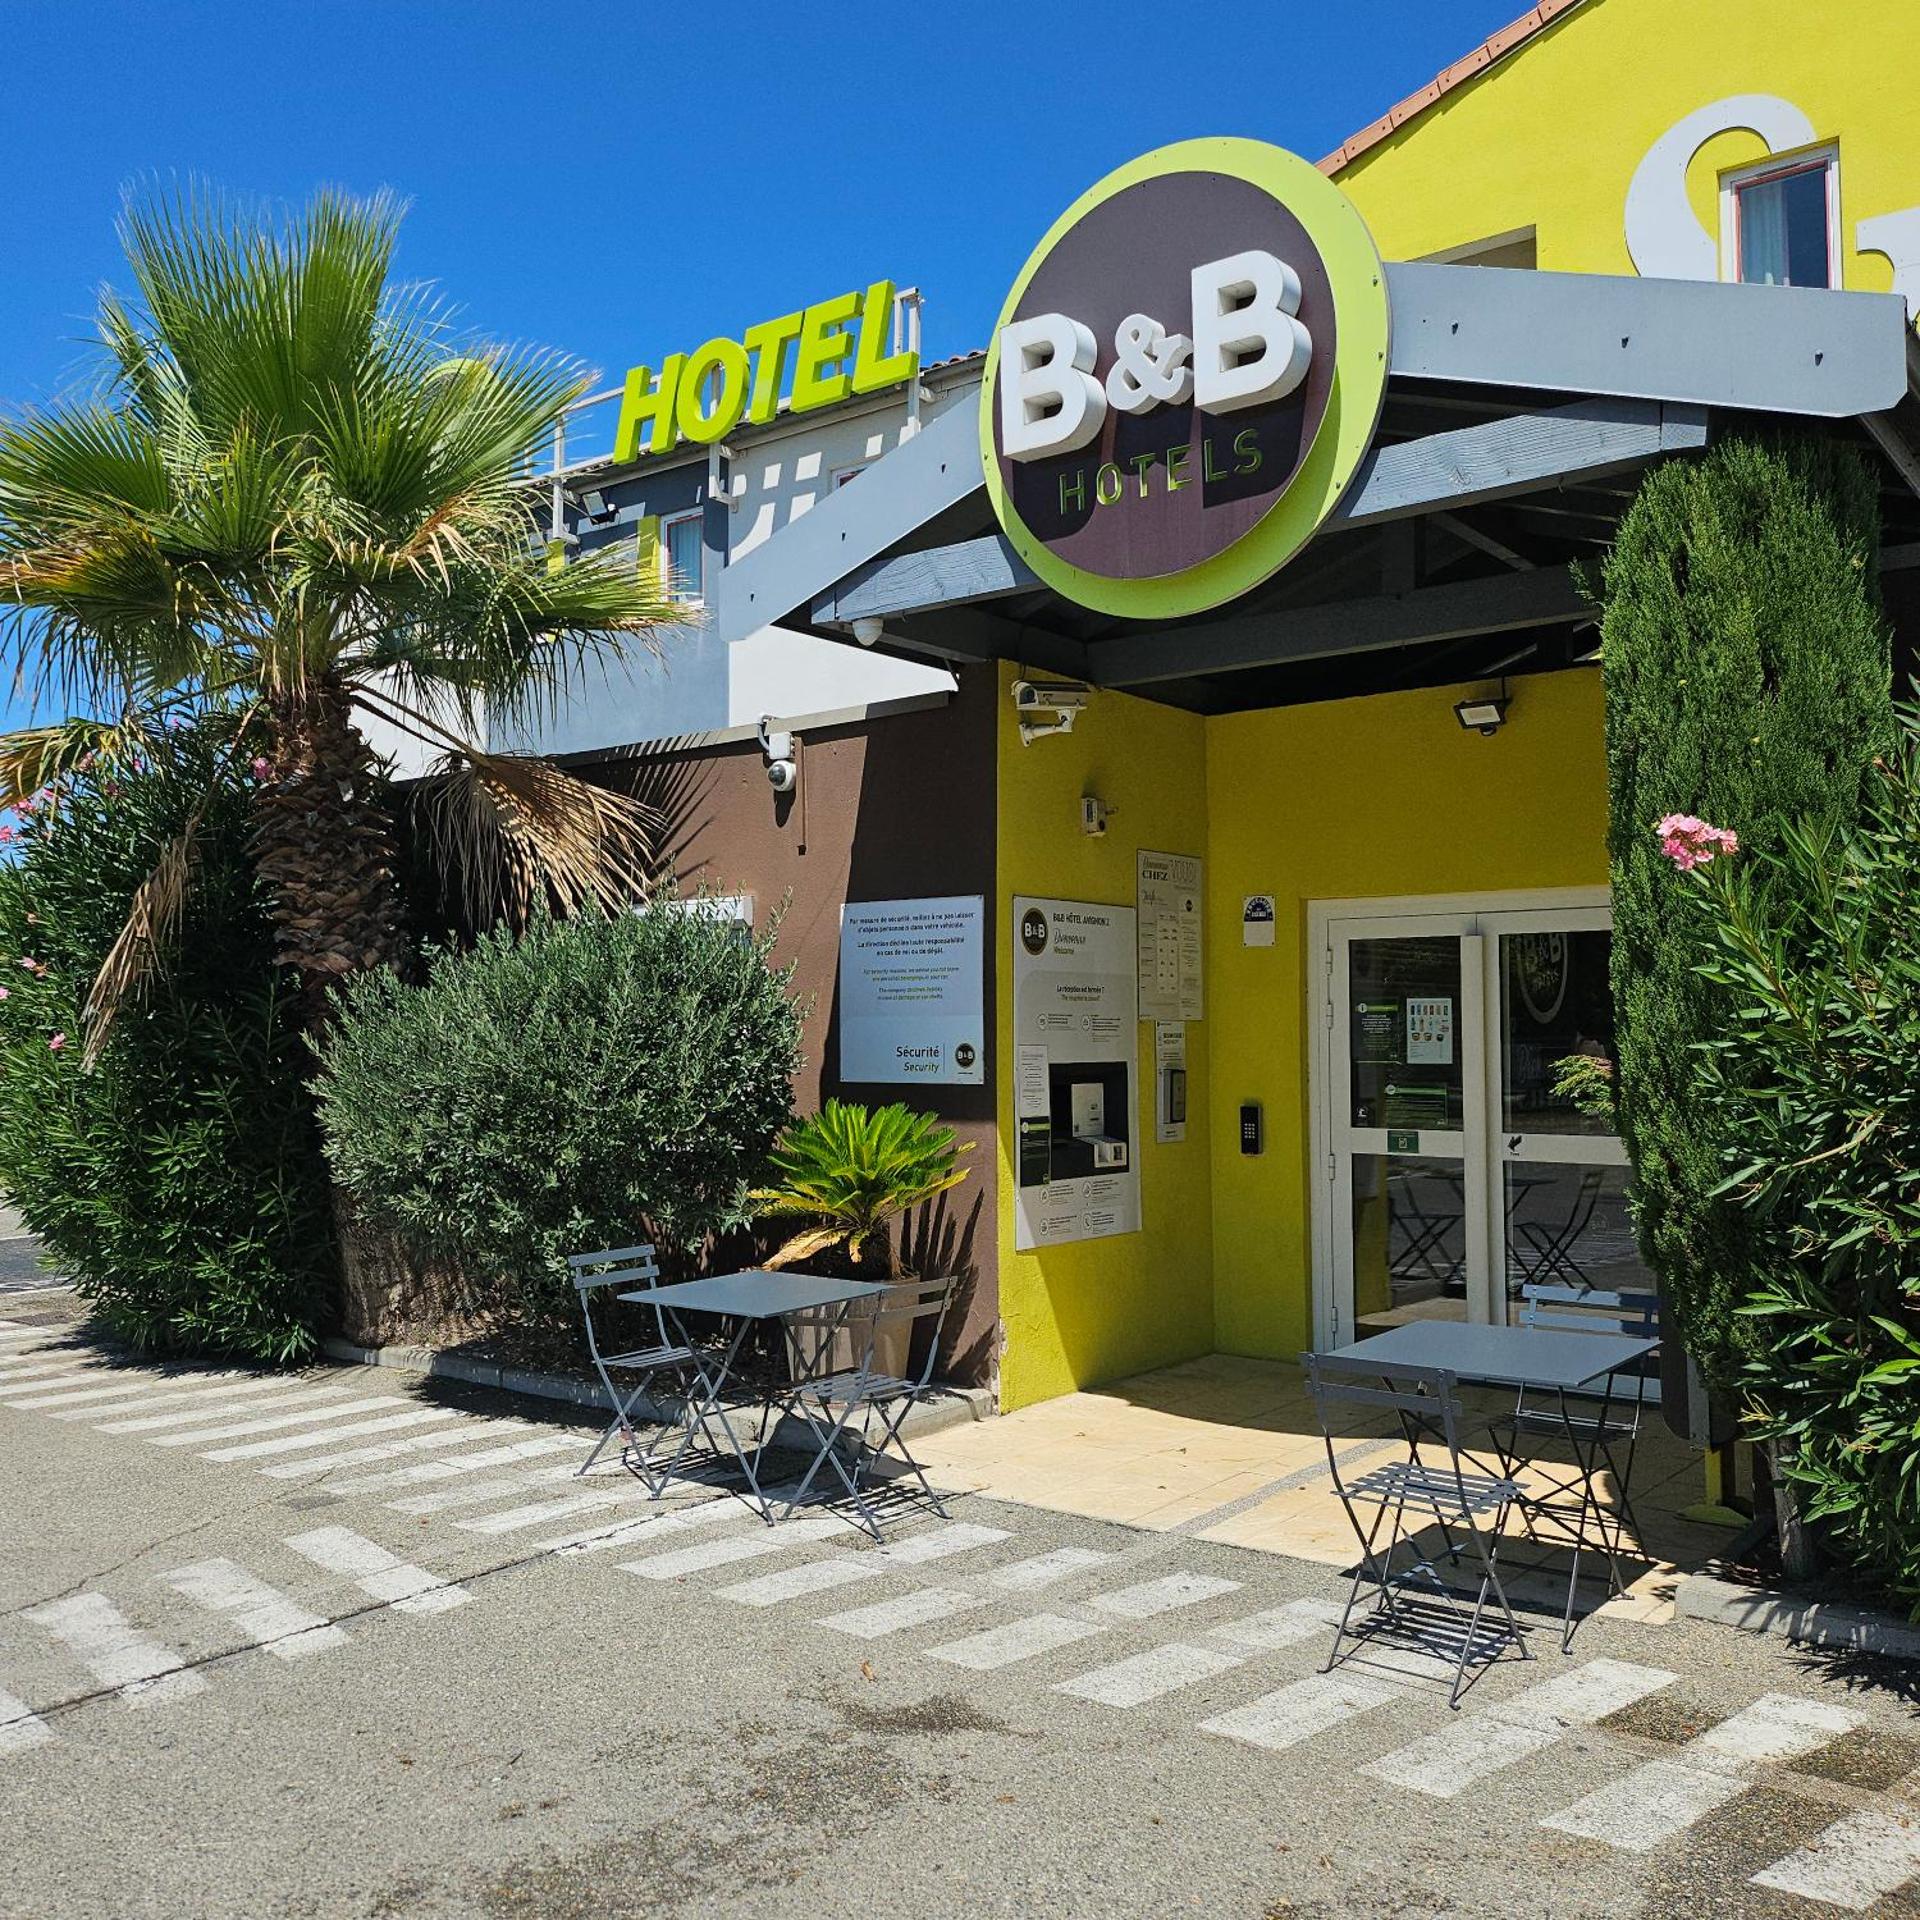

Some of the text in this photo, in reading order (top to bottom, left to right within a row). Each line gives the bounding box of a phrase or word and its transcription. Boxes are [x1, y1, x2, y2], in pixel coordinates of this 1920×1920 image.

[613, 278, 919, 465] HOTEL
[1000, 250, 1313, 464] B&B
[1059, 428, 1265, 516] HOTELS
[1024, 922, 1046, 939] B&B
[896, 1045, 940, 1058] Sécurité
[904, 1062, 940, 1074] Security
